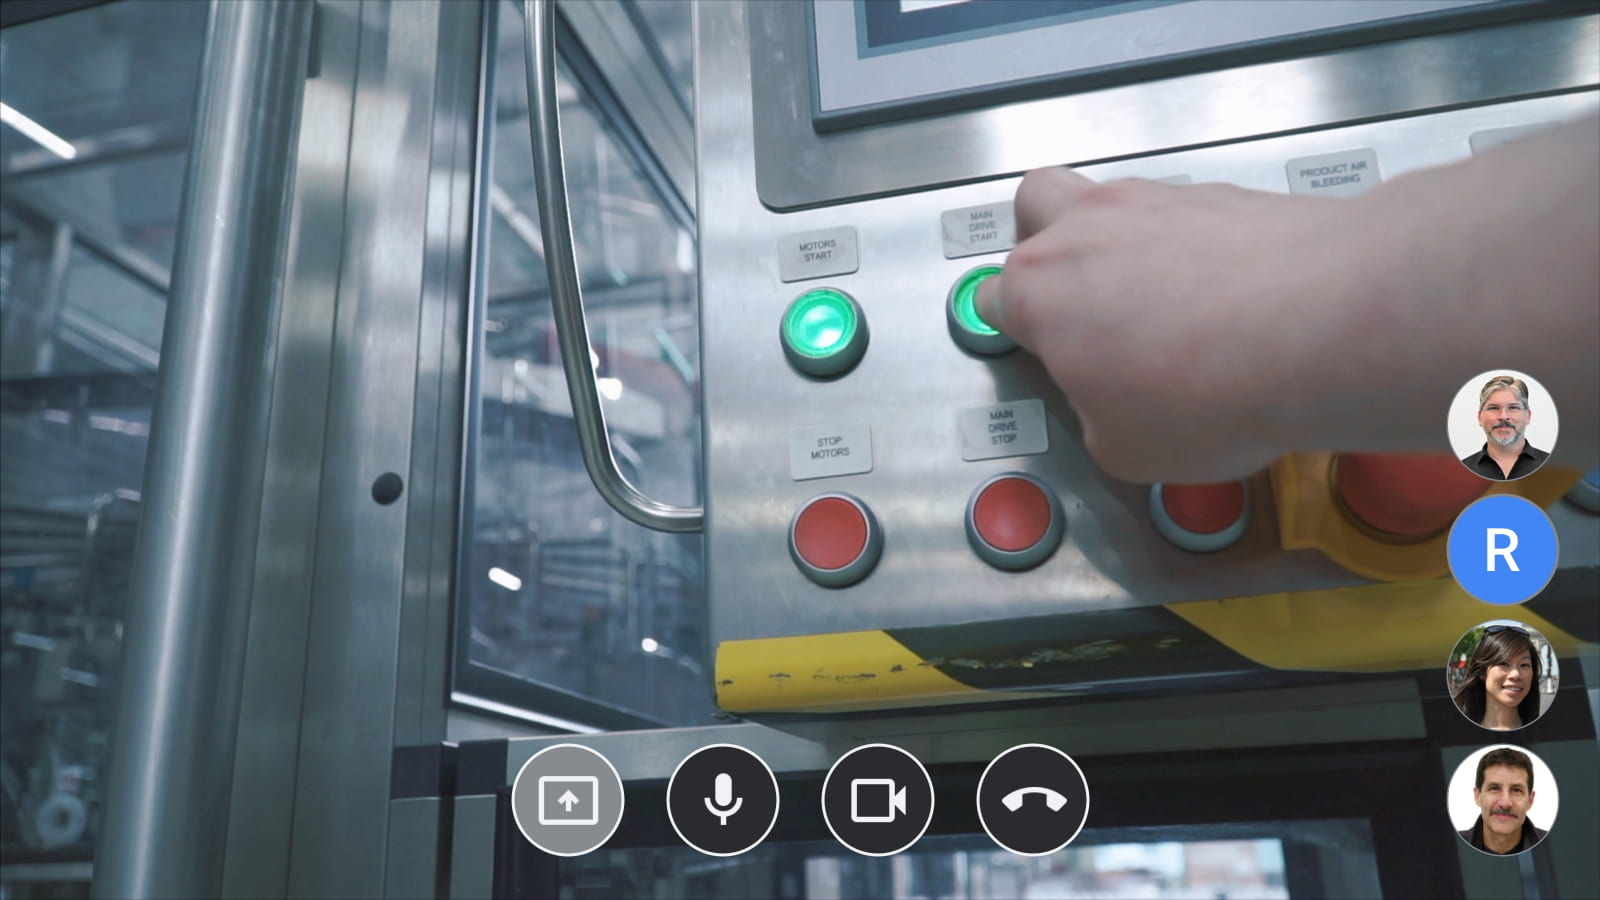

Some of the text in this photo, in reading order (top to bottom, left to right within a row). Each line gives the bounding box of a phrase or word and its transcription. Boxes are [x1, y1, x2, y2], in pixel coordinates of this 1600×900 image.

[1300, 160, 1368, 178] PRODUCT AIR
[1311, 173, 1361, 189] BLEEDING
[970, 210, 993, 221] MAIN
[969, 220, 995, 232] DRIVE
[969, 231, 998, 243] START
[799, 239, 837, 251] MOTORS
[804, 250, 832, 262] START
[990, 408, 1014, 419] MAIN
[988, 420, 1017, 433] DRIVE
[817, 435, 843, 447] STOP
[991, 433, 1017, 445] STOP
[811, 447, 850, 459] MOTORS
